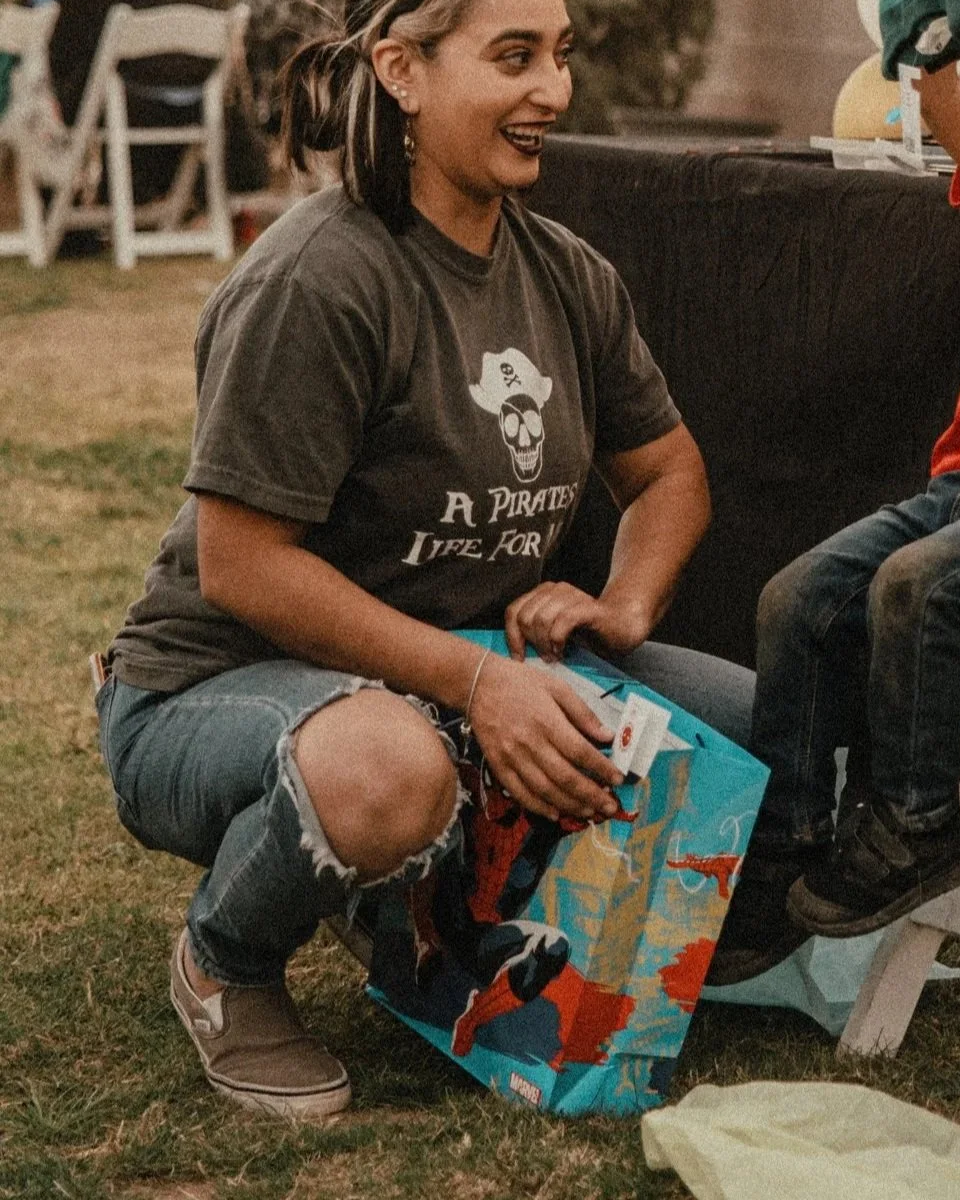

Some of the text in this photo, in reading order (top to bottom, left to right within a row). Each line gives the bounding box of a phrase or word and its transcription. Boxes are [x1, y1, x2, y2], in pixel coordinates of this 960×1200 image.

[439, 484, 578, 528] A PIRATES
[401, 530, 484, 567] LIFE
[487, 528, 544, 562] FOR
